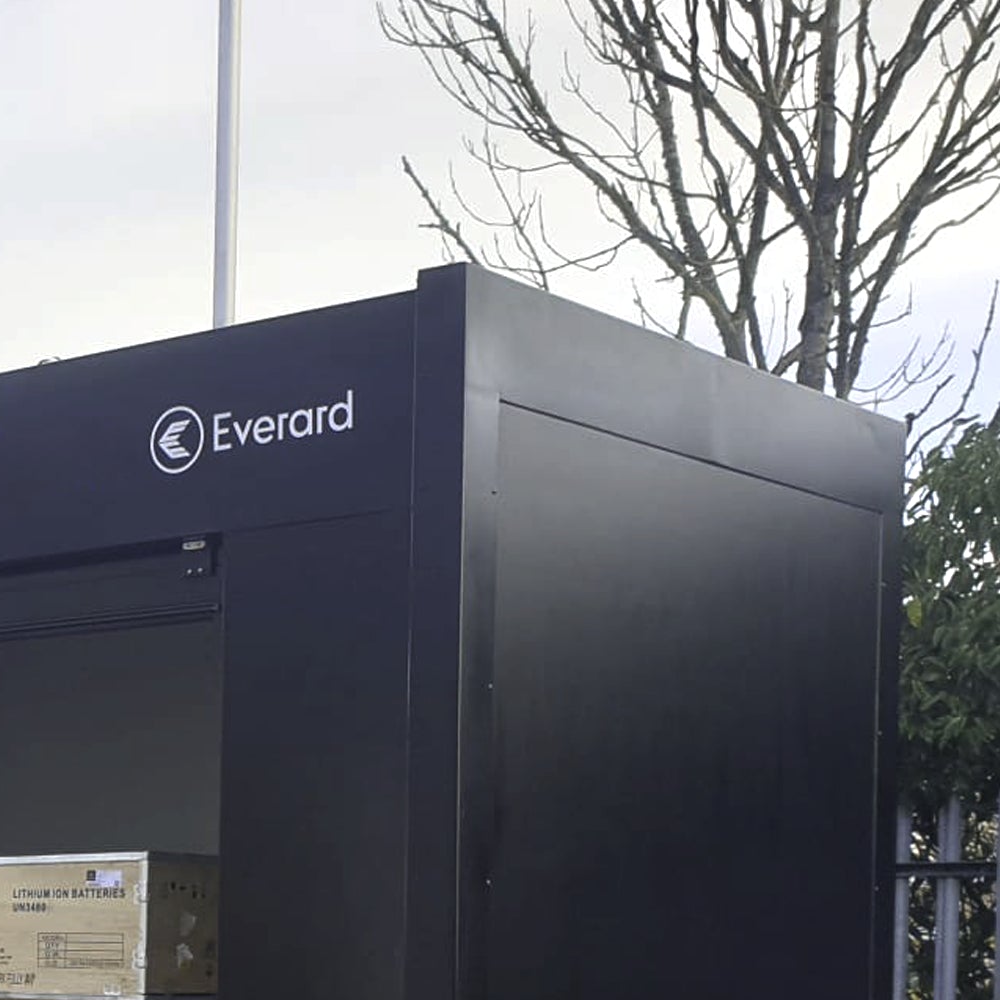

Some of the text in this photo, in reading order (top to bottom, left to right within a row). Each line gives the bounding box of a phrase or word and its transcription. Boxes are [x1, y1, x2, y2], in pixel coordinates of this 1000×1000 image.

[213, 389, 354, 452] Everard
[12, 887, 126, 899] LITHIUM ION BATTERIES
